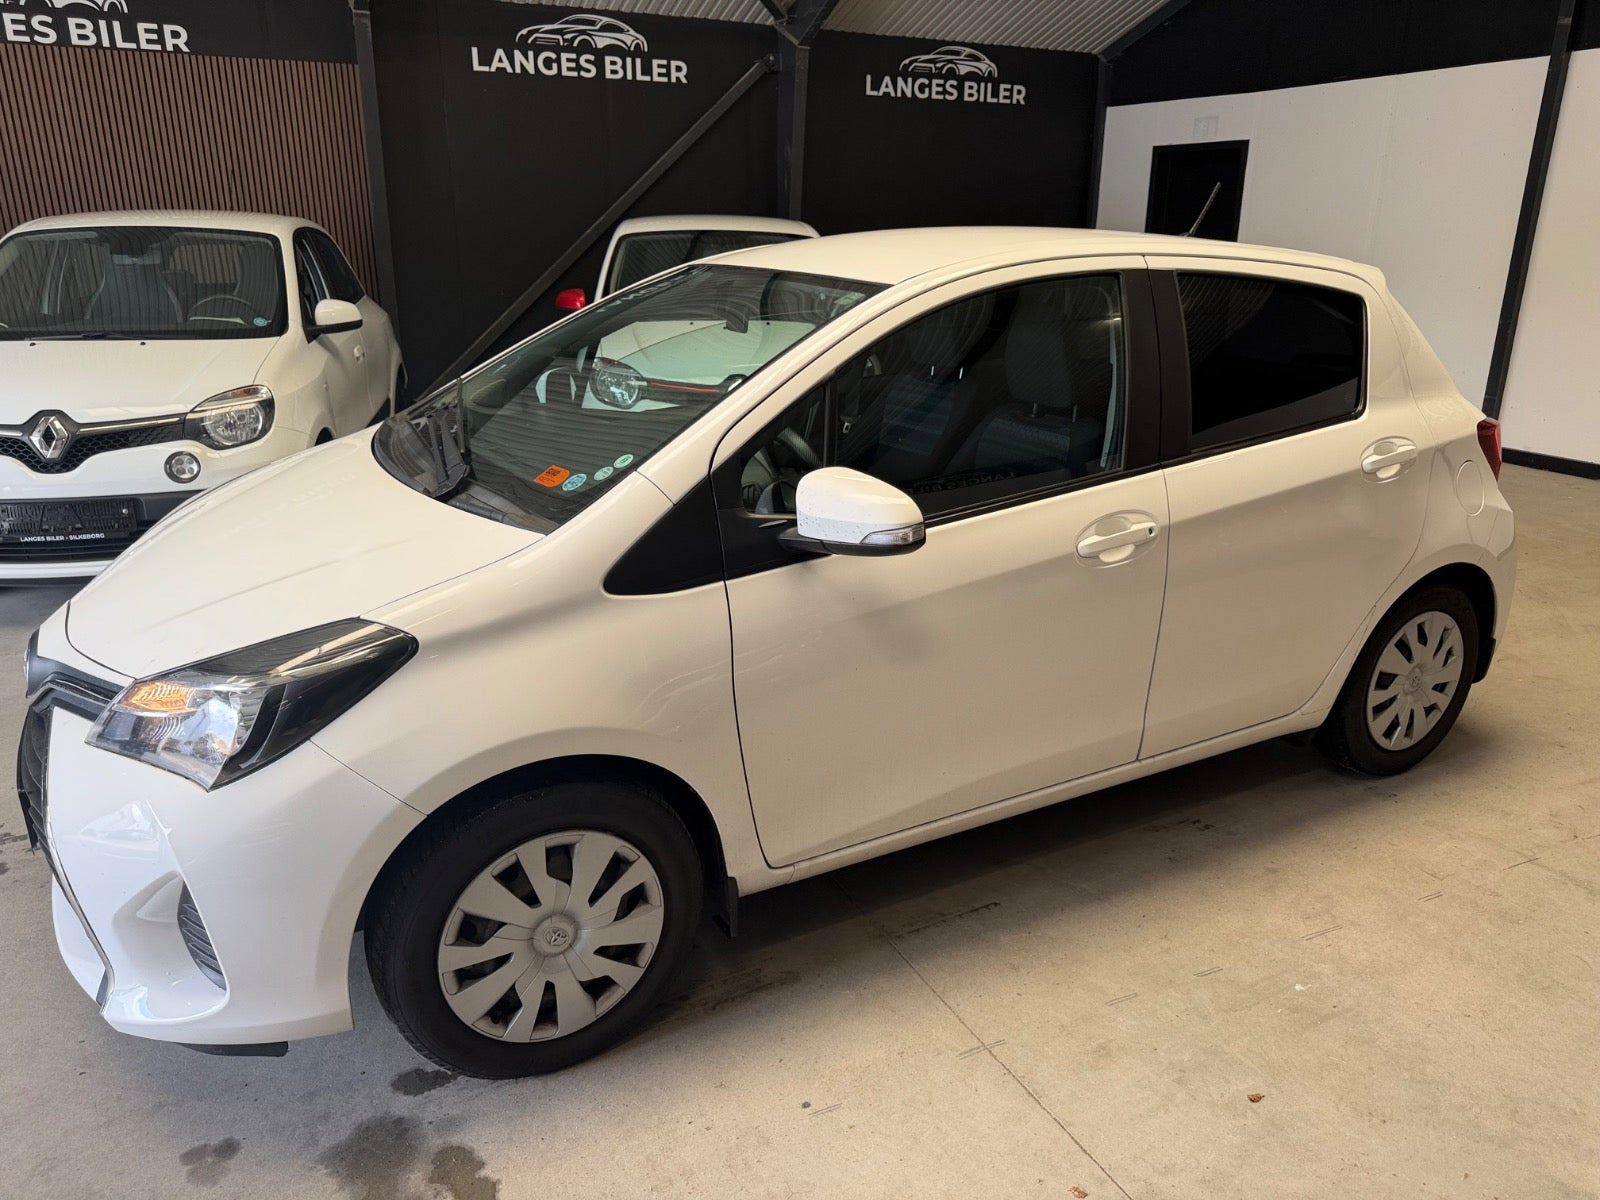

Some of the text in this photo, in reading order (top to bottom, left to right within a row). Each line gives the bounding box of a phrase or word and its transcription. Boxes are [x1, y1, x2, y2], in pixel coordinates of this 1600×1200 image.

[67, 16, 190, 53] BILER
[471, 46, 688, 84] LANGES BILER
[865, 74, 1026, 105] LANGES BILER
